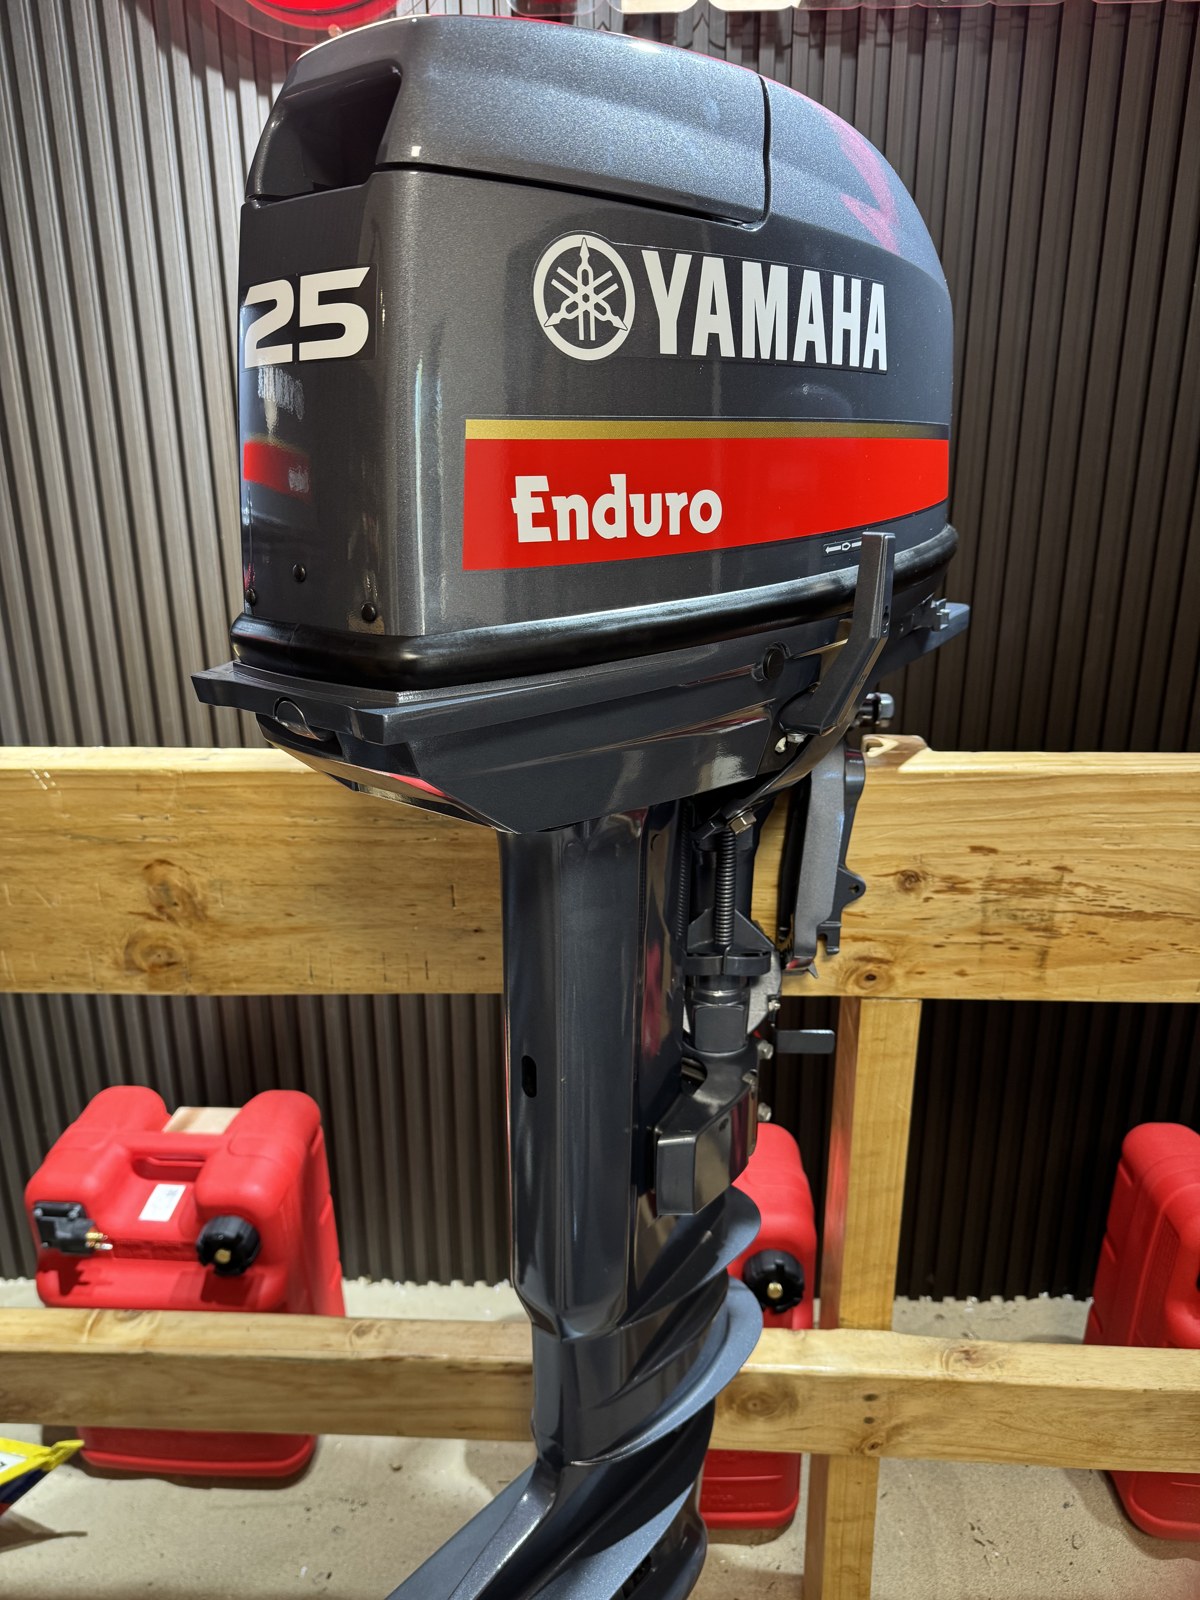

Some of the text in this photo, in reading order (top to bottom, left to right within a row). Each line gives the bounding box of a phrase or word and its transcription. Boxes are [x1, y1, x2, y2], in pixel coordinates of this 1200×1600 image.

[244, 267, 370, 368] 25
[641, 250, 887, 371] YAMAHA
[511, 474, 722, 542] Enduro
